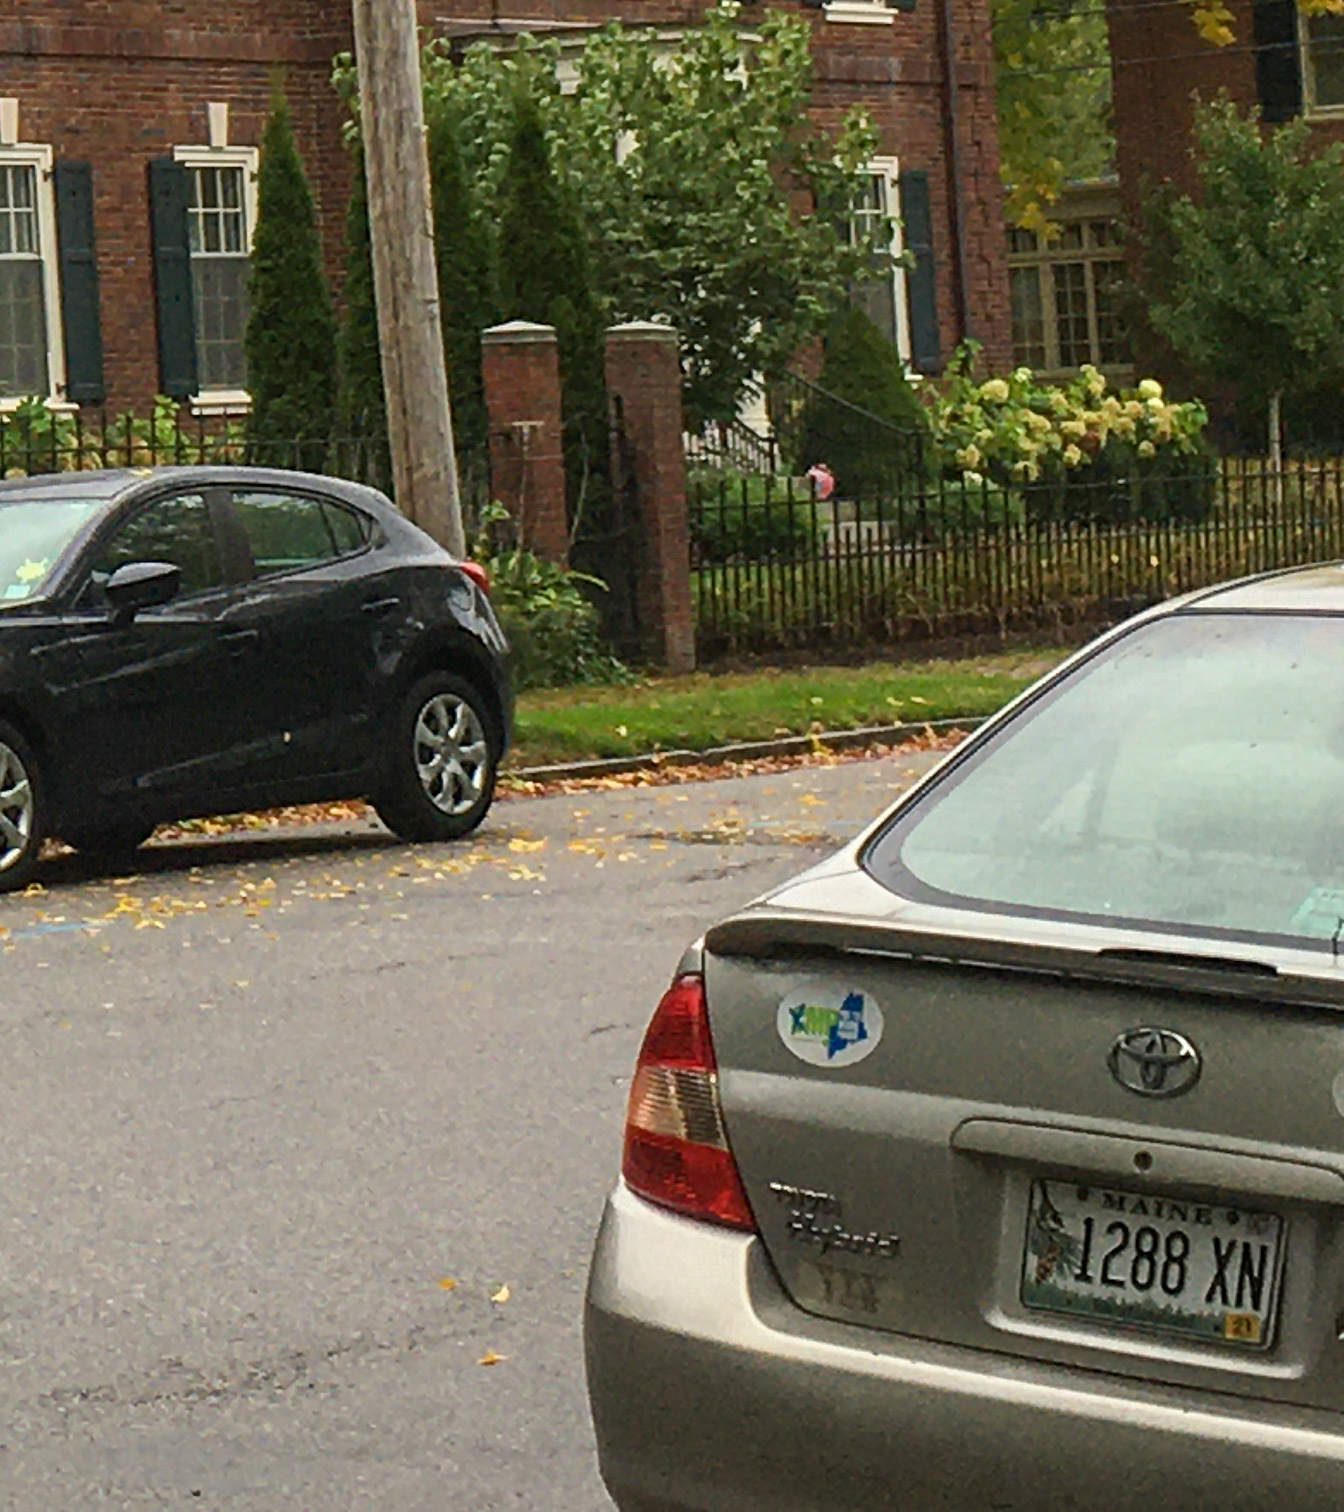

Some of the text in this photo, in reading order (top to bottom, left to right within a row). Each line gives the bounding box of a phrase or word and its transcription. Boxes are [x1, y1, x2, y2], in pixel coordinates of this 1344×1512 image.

[1101, 1191, 1213, 1226] MAINE
[1073, 1216, 1269, 1312] 1288 XN
